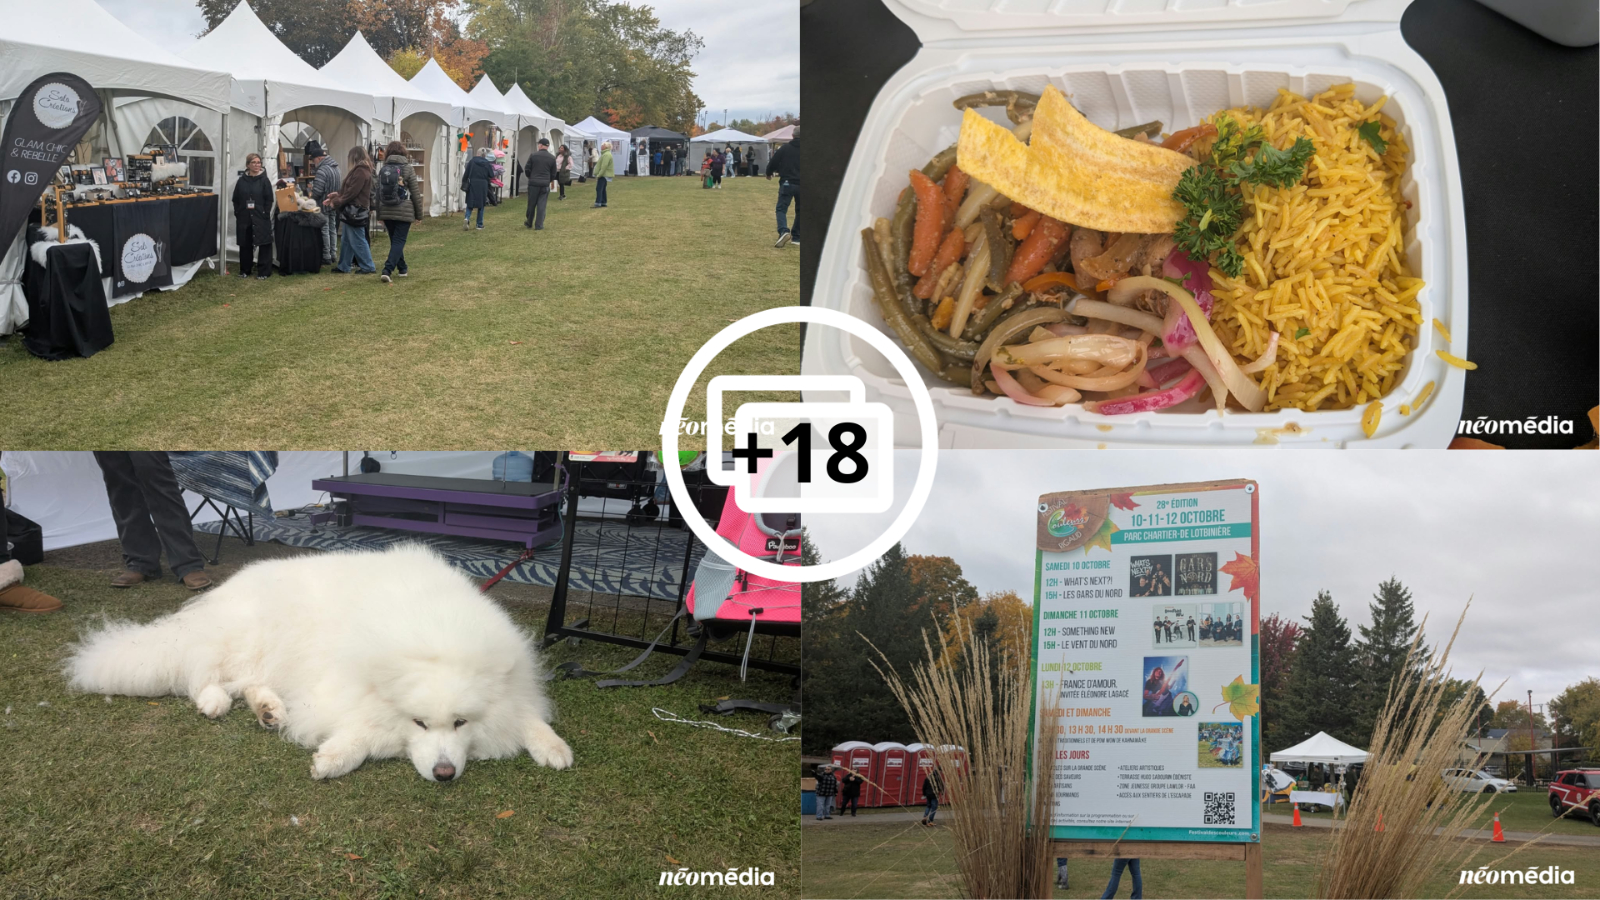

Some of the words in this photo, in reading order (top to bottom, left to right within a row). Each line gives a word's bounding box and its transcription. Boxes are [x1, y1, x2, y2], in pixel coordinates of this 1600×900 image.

[14, 137, 44, 151] GLAM
[45, 142, 68, 153] CHIC
[10, 148, 19, 157] &
[21, 150, 59, 163] REBELLE
[1170, 498, 1199, 509] ÉDITION
[1179, 508, 1226, 524] OCTOBRE
[1123, 531, 1142, 542] PARC
[1143, 528, 1189, 540] CHARTIER-DE
[1190, 525, 1232, 538] LOTBINIÈRE
[1057, 531, 1082, 550] RIGAUD
[1045, 561, 1070, 571] SAMEDI
[1072, 560, 1081, 570] 10
[1081, 560, 1111, 570] OCTOBRE
[1045, 578, 1058, 587] 12H
[1063, 577, 1088, 586] WHAT'S
[1089, 576, 1113, 585] NEXT?!
[1045, 591, 1058, 600] 15H
[1063, 590, 1075, 600] LES
[1076, 589, 1094, 599] GARS
[1095, 589, 1104, 598] DU
[1105, 588, 1123, 598] NORD
[1043, 610, 1077, 620] DIMANCHE
[1080, 610, 1087, 619] 11
[1088, 609, 1119, 618] OCTOBRE
[1043, 627, 1056, 637] 12H
[1061, 626, 1099, 636] SOMETHING
[1100, 626, 1116, 635] NEW
[1043, 640, 1056, 650] 15H
[1061, 640, 1069, 649] LE
[1070, 639, 1088, 649] VENT
[1089, 639, 1098, 648] DU
[1099, 639, 1118, 648] NORD
[1041, 662, 1061, 672] LUNDI
[1062, 662, 1072, 671] 12
[1072, 662, 1103, 671] OCTOBRE
[1066, 708, 1075, 717] ET
[1075, 707, 1112, 717] DIMANCHE
[1068, 725, 1077, 734] 13
[1078, 725, 1084, 734] H
[1098, 725, 1106, 734] 14
[1107, 725, 1113, 734] H
[1114, 725, 1124, 734] 30
[1055, 750, 1068, 760] LES
[1069, 750, 1090, 760] JOURS
